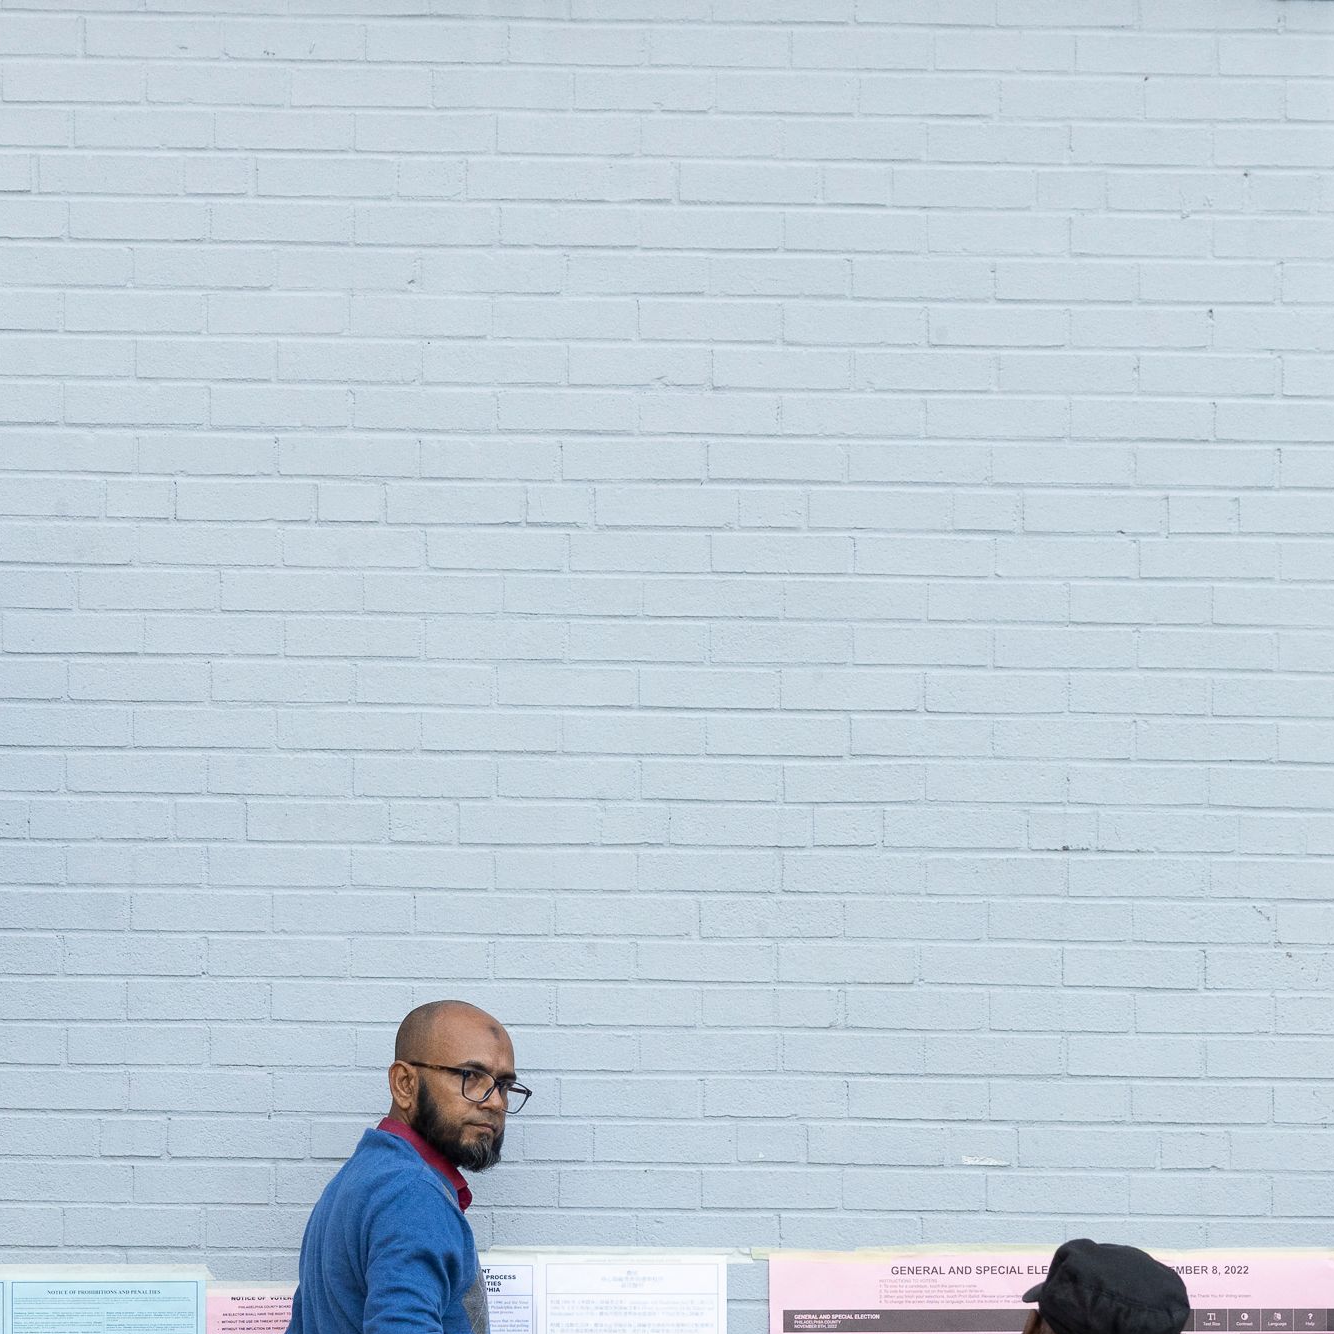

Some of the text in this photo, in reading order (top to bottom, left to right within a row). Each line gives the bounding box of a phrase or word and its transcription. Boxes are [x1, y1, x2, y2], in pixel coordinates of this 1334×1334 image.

[891, 1266, 1048, 1275] GENERAL AND SPECIAL ELE
[1171, 1266, 1249, 1276] MBER 8, 2022
